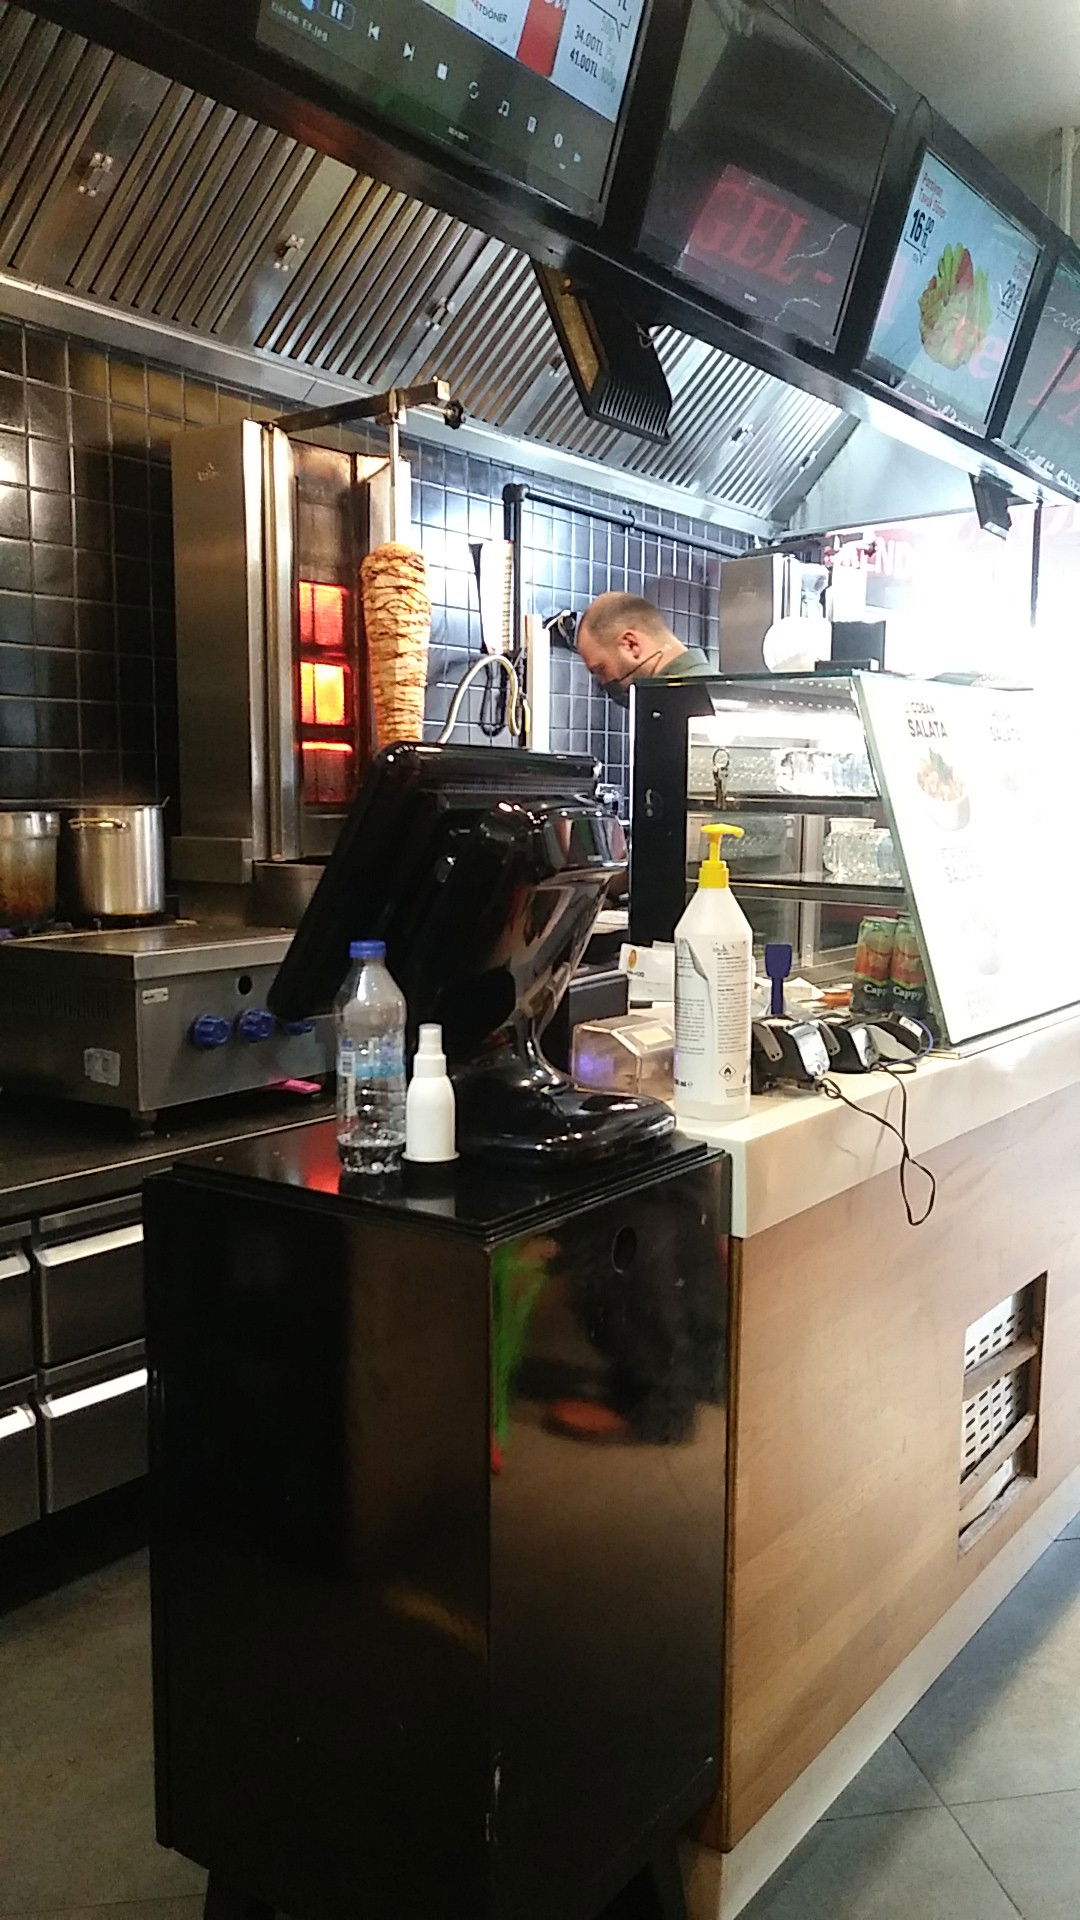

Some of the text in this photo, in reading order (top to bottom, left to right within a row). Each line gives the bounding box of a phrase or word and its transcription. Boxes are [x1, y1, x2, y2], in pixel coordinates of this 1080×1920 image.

[574, 24, 604, 57] 34.00TL
[569, 48, 598, 79] 41.00TL
[909, 209, 926, 242] 16
[907, 718, 949, 738] SALATA
[892, 985, 923, 1001] Cappy
